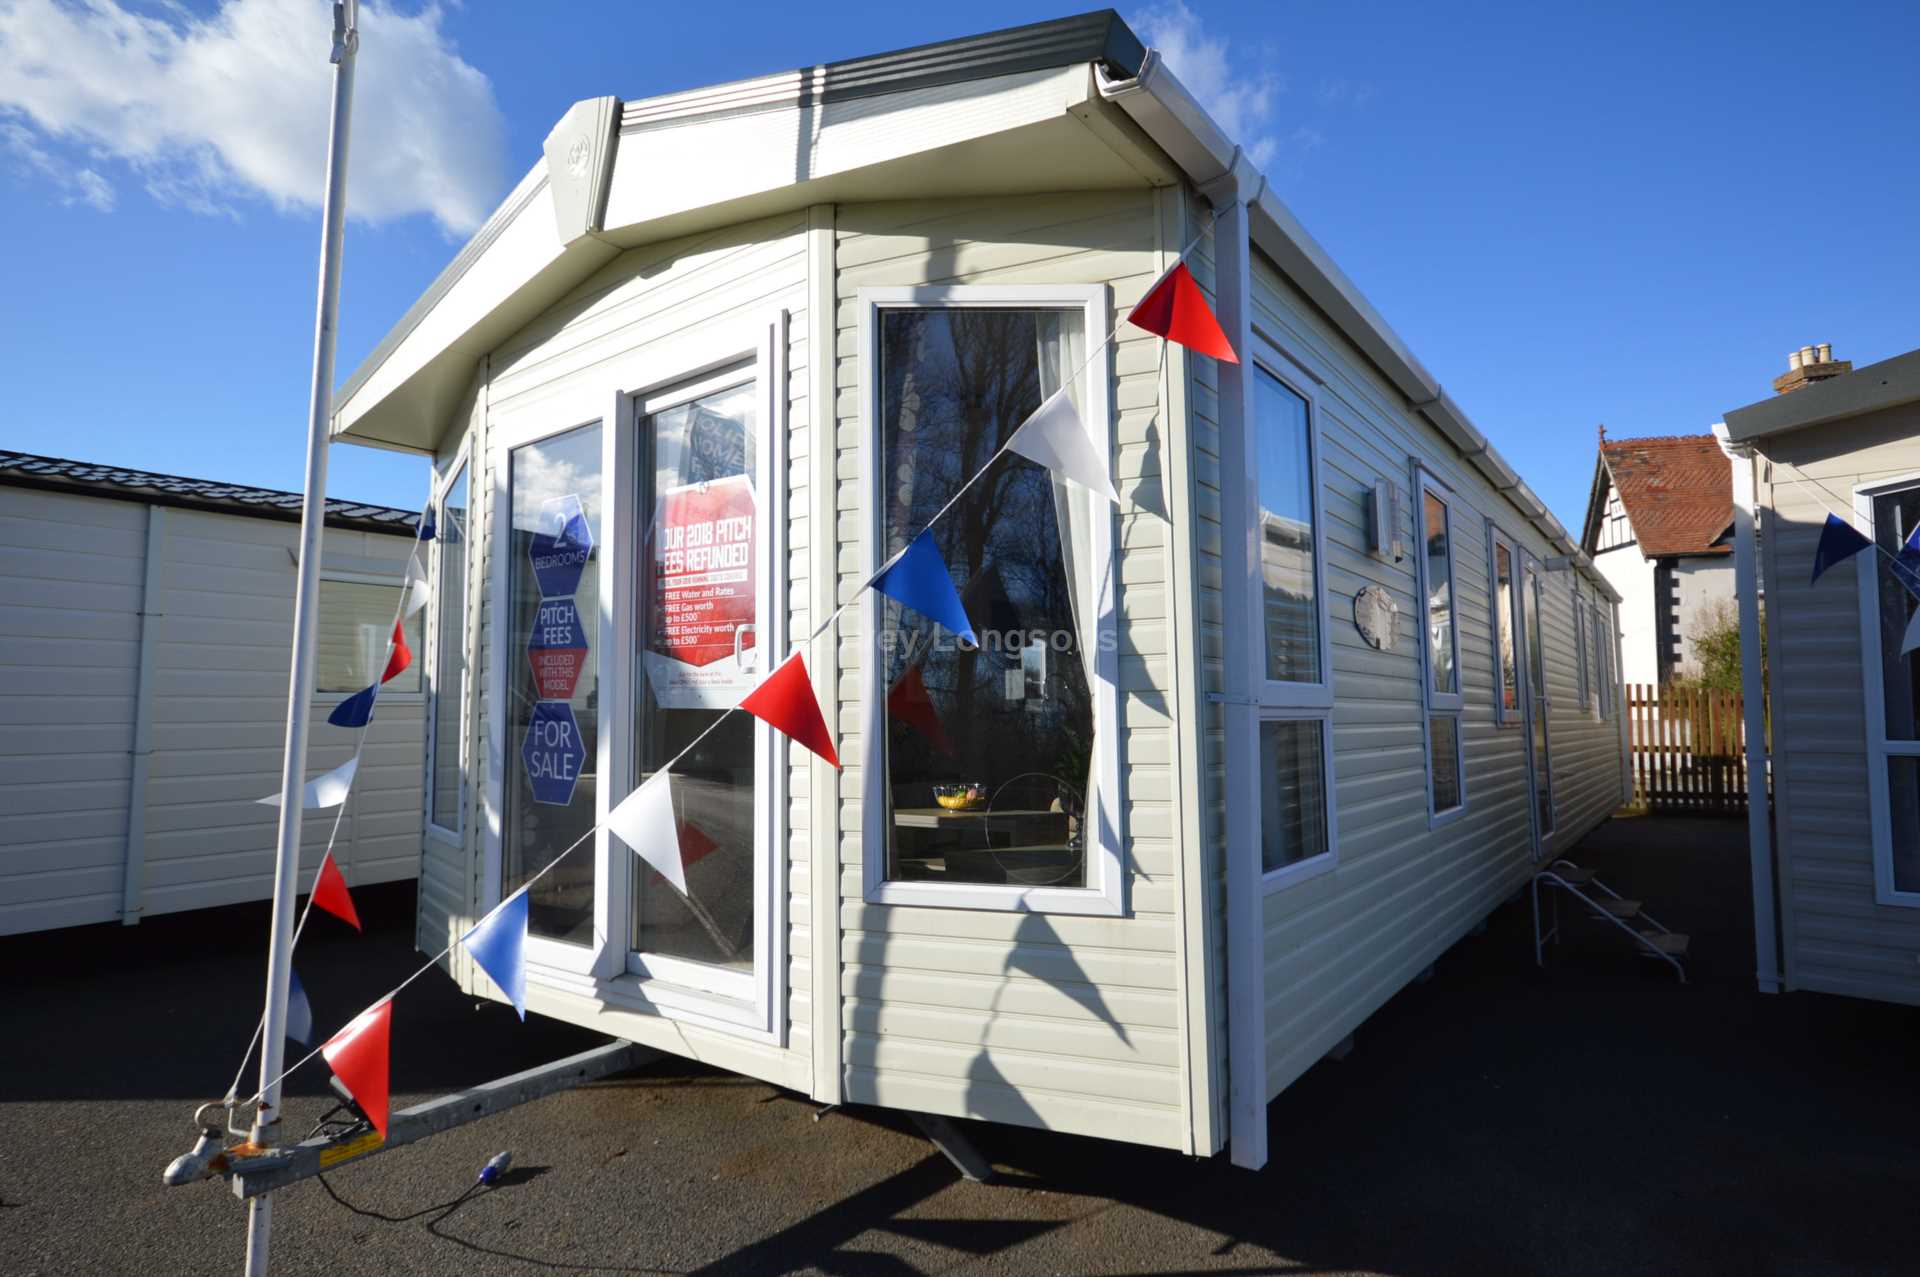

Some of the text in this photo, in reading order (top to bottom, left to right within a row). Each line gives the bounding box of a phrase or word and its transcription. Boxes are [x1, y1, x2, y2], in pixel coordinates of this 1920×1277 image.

[553, 512, 567, 548] 2
[664, 515, 752, 550] OUR 2018 PITCH
[535, 550, 585, 570] BEDROOMS
[664, 541, 749, 574] EES REFUNDED
[665, 586, 734, 600] FREE Water and Rates
[681, 603, 694, 611] Gas
[694, 600, 714, 610] worth
[540, 606, 575, 625] PITCH
[543, 627, 572, 645] FEES
[681, 625, 713, 635] Electricity
[713, 622, 735, 633] worth
[543, 679, 569, 691] MODEL
[534, 719, 573, 748] FOR
[531, 751, 575, 781] SALE
